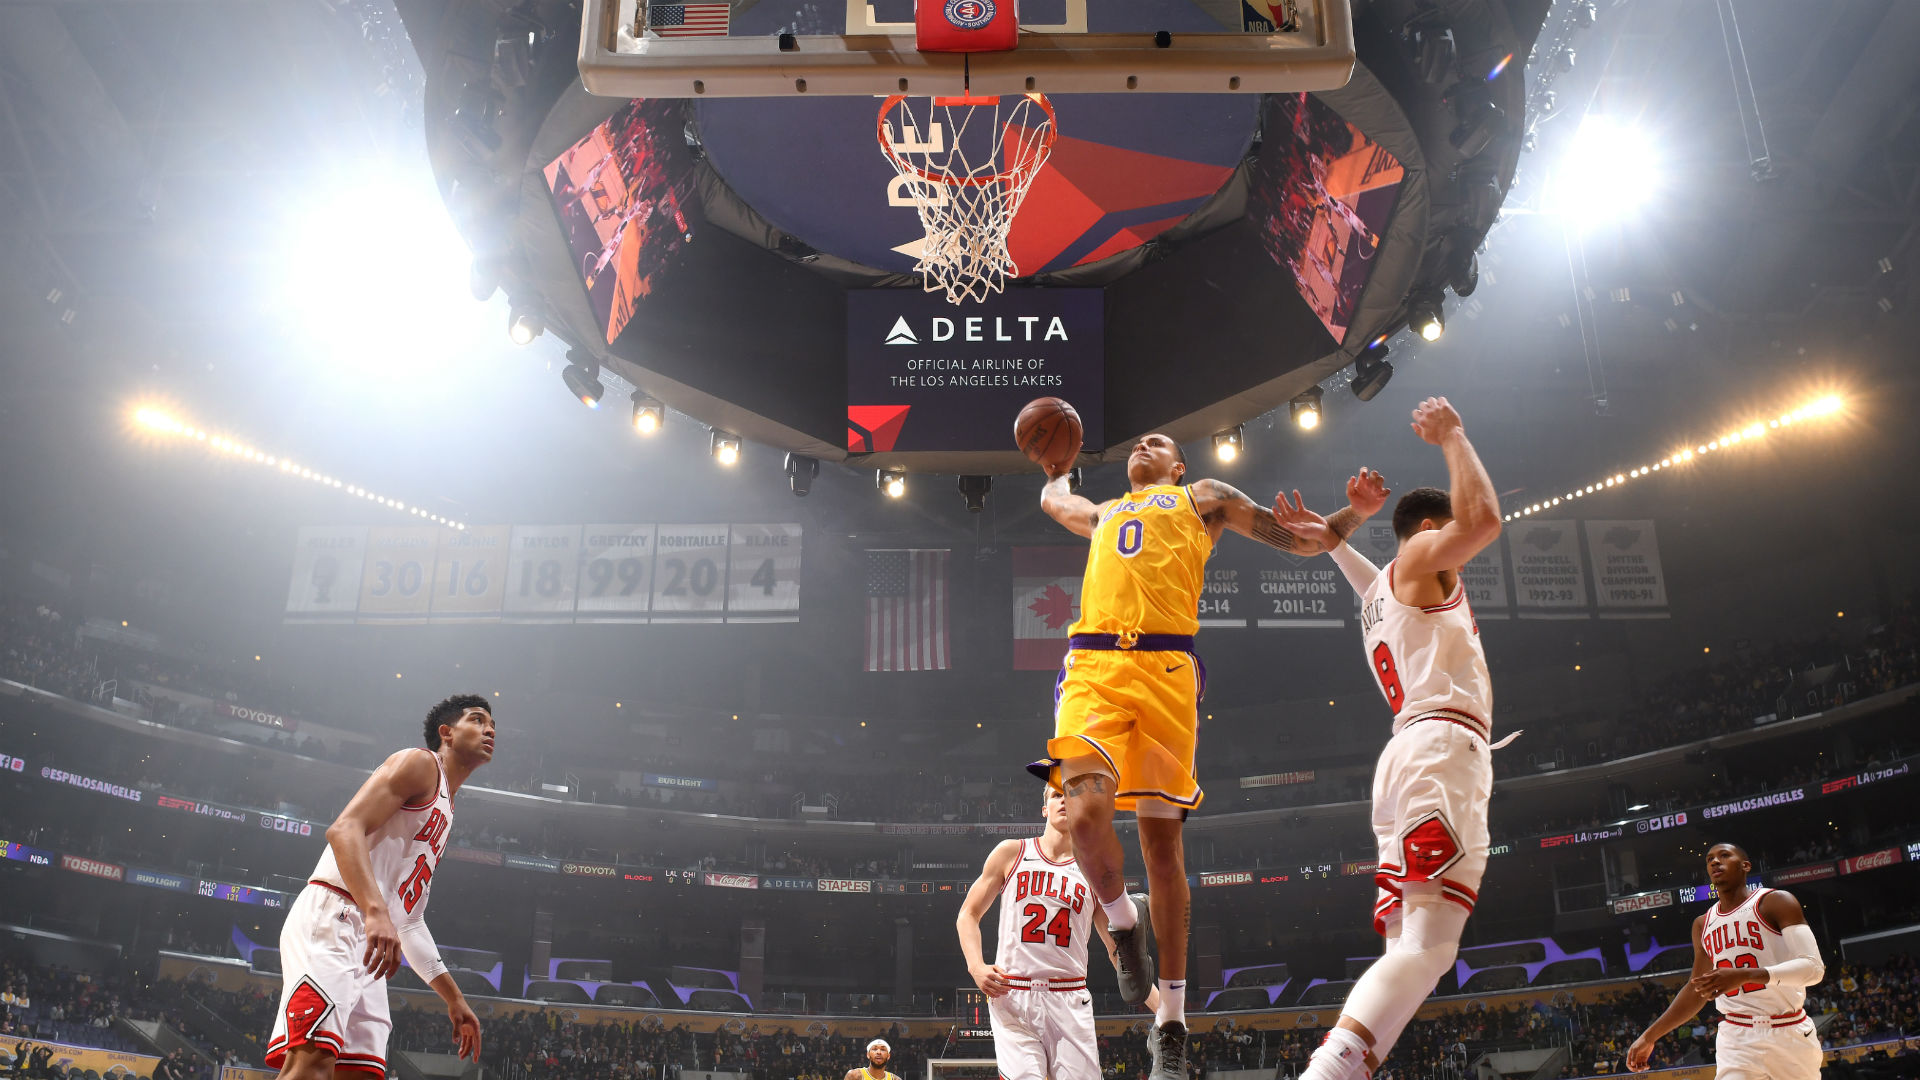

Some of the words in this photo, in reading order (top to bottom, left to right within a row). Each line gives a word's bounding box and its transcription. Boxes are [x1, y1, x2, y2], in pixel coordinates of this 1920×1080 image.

[1248, 21, 1269, 32] NBA
[932, 317, 1068, 341] DELTA
[907, 359, 967, 371] OFFICIAL
[972, 359, 1023, 370] AIRLINE
[1027, 359, 1045, 370] OF
[890, 375, 916, 387] THE
[920, 376, 945, 386] LOS
[949, 375, 1009, 386] ANGELES
[1013, 375, 1062, 386] LAKERS
[589, 535, 647, 547] GRETZKY
[660, 535, 725, 547] ROBITAILLE
[745, 535, 789, 547] BLAKE
[1116, 518, 1144, 558] 0
[1521, 555, 1570, 564] CAMPBELL
[1214, 569, 1238, 581] CUP
[1260, 570, 1308, 581] STANLEY
[1312, 570, 1335, 581] CUP
[1518, 566, 1579, 575] CONFERENCE
[371, 559, 424, 597] 30
[448, 559, 489, 597] 16
[519, 558, 563, 597] 18
[588, 558, 643, 597] 99
[662, 558, 718, 597] 20
[750, 557, 777, 597] 4
[1521, 577, 1577, 586] CHAMPIONS
[1601, 576, 1657, 585] CHAMPIONS
[1260, 582, 1337, 594] CHAMPIONS
[1529, 590, 1573, 600] 1992-93
[1199, 599, 1230, 613] 3-14
[1273, 599, 1327, 613] 2011-12
[1373, 640, 1405, 715] 8
[229, 704, 284, 728] TOYOTA
[41, 766, 142, 802] @ESPNLOSANGELES
[677, 778, 702, 787] LIGHT
[1703, 788, 1805, 819] @ESPNLOSANGELES
[30, 854, 49, 865] NBA
[63, 856, 122, 878] TOSHIBA
[578, 865, 616, 876] TOYOTA
[1300, 866, 1313, 874] LAL
[1318, 864, 1331, 872] CHI
[624, 874, 653, 882] BLOCKS
[683, 870, 696, 878] CHI
[1201, 873, 1252, 886] TOSHIBA
[1260, 875, 1289, 883] BLOCKS
[136, 874, 155, 884] BUD
[156, 877, 182, 888] LIGHT
[200, 880, 217, 890] PHO
[398, 853, 432, 915] 15
[775, 880, 814, 889] DELTA
[818, 879, 869, 892] STAPLES
[198, 888, 214, 897] IND
[1016, 871, 1086, 914] BULLS
[1680, 887, 1696, 897] PHO
[264, 898, 281, 907] NBA
[1614, 893, 1671, 912] STAPLES
[1680, 894, 1695, 903] IND
[1021, 902, 1072, 948] 24
[1703, 920, 1764, 961] BULLS
